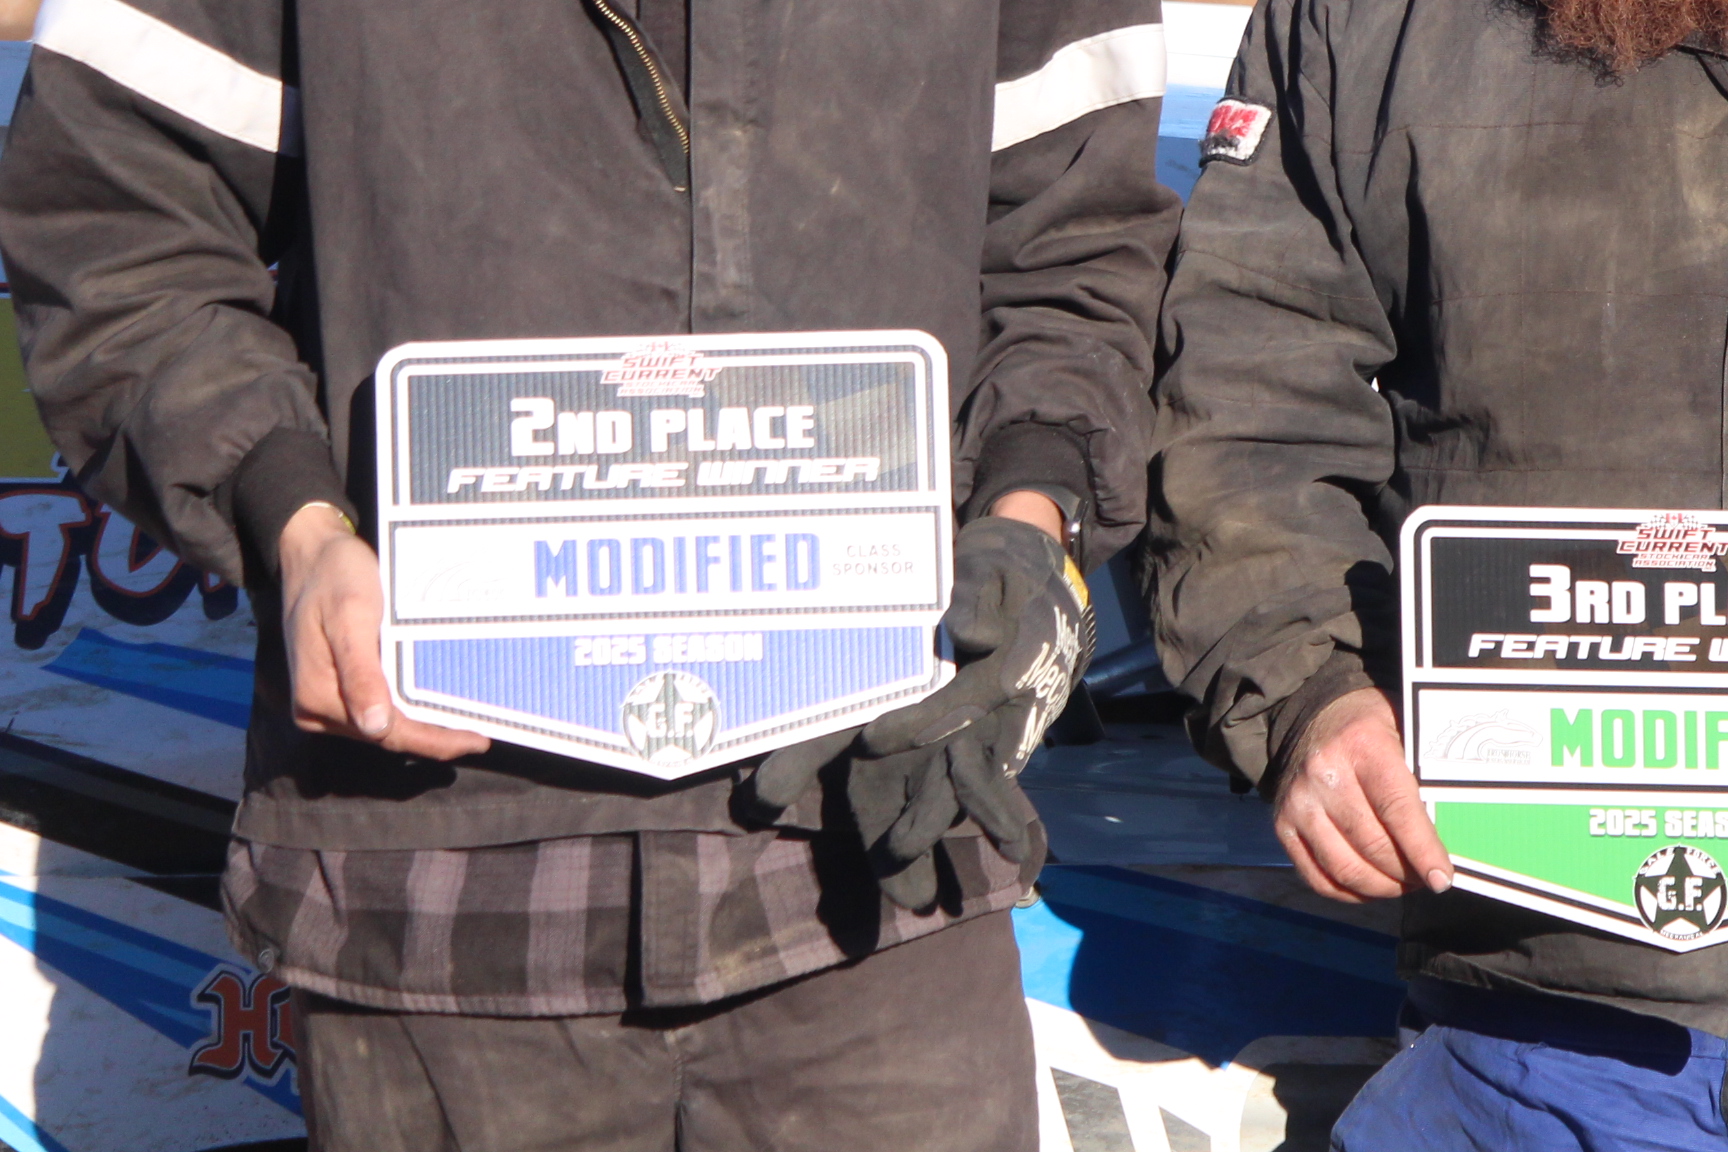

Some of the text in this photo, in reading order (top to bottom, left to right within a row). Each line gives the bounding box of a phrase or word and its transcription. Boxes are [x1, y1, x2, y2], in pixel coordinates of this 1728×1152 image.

[604, 367, 721, 381] CURRENT
[622, 354, 700, 368] SWIFT
[510, 397, 816, 457] 2ND PLACE
[446, 457, 881, 494] FEATURE WINNER
[1636, 528, 1713, 540] SWIFT
[846, 543, 901, 558] CLASS
[533, 532, 820, 599] MODIFIED
[832, 561, 914, 576] SPONSOR
[1529, 564, 1646, 624] 3RD
[574, 633, 763, 666] 2025 SEASON
[1468, 634, 1699, 662] FEATURE
[1589, 809, 1658, 837] 2025
